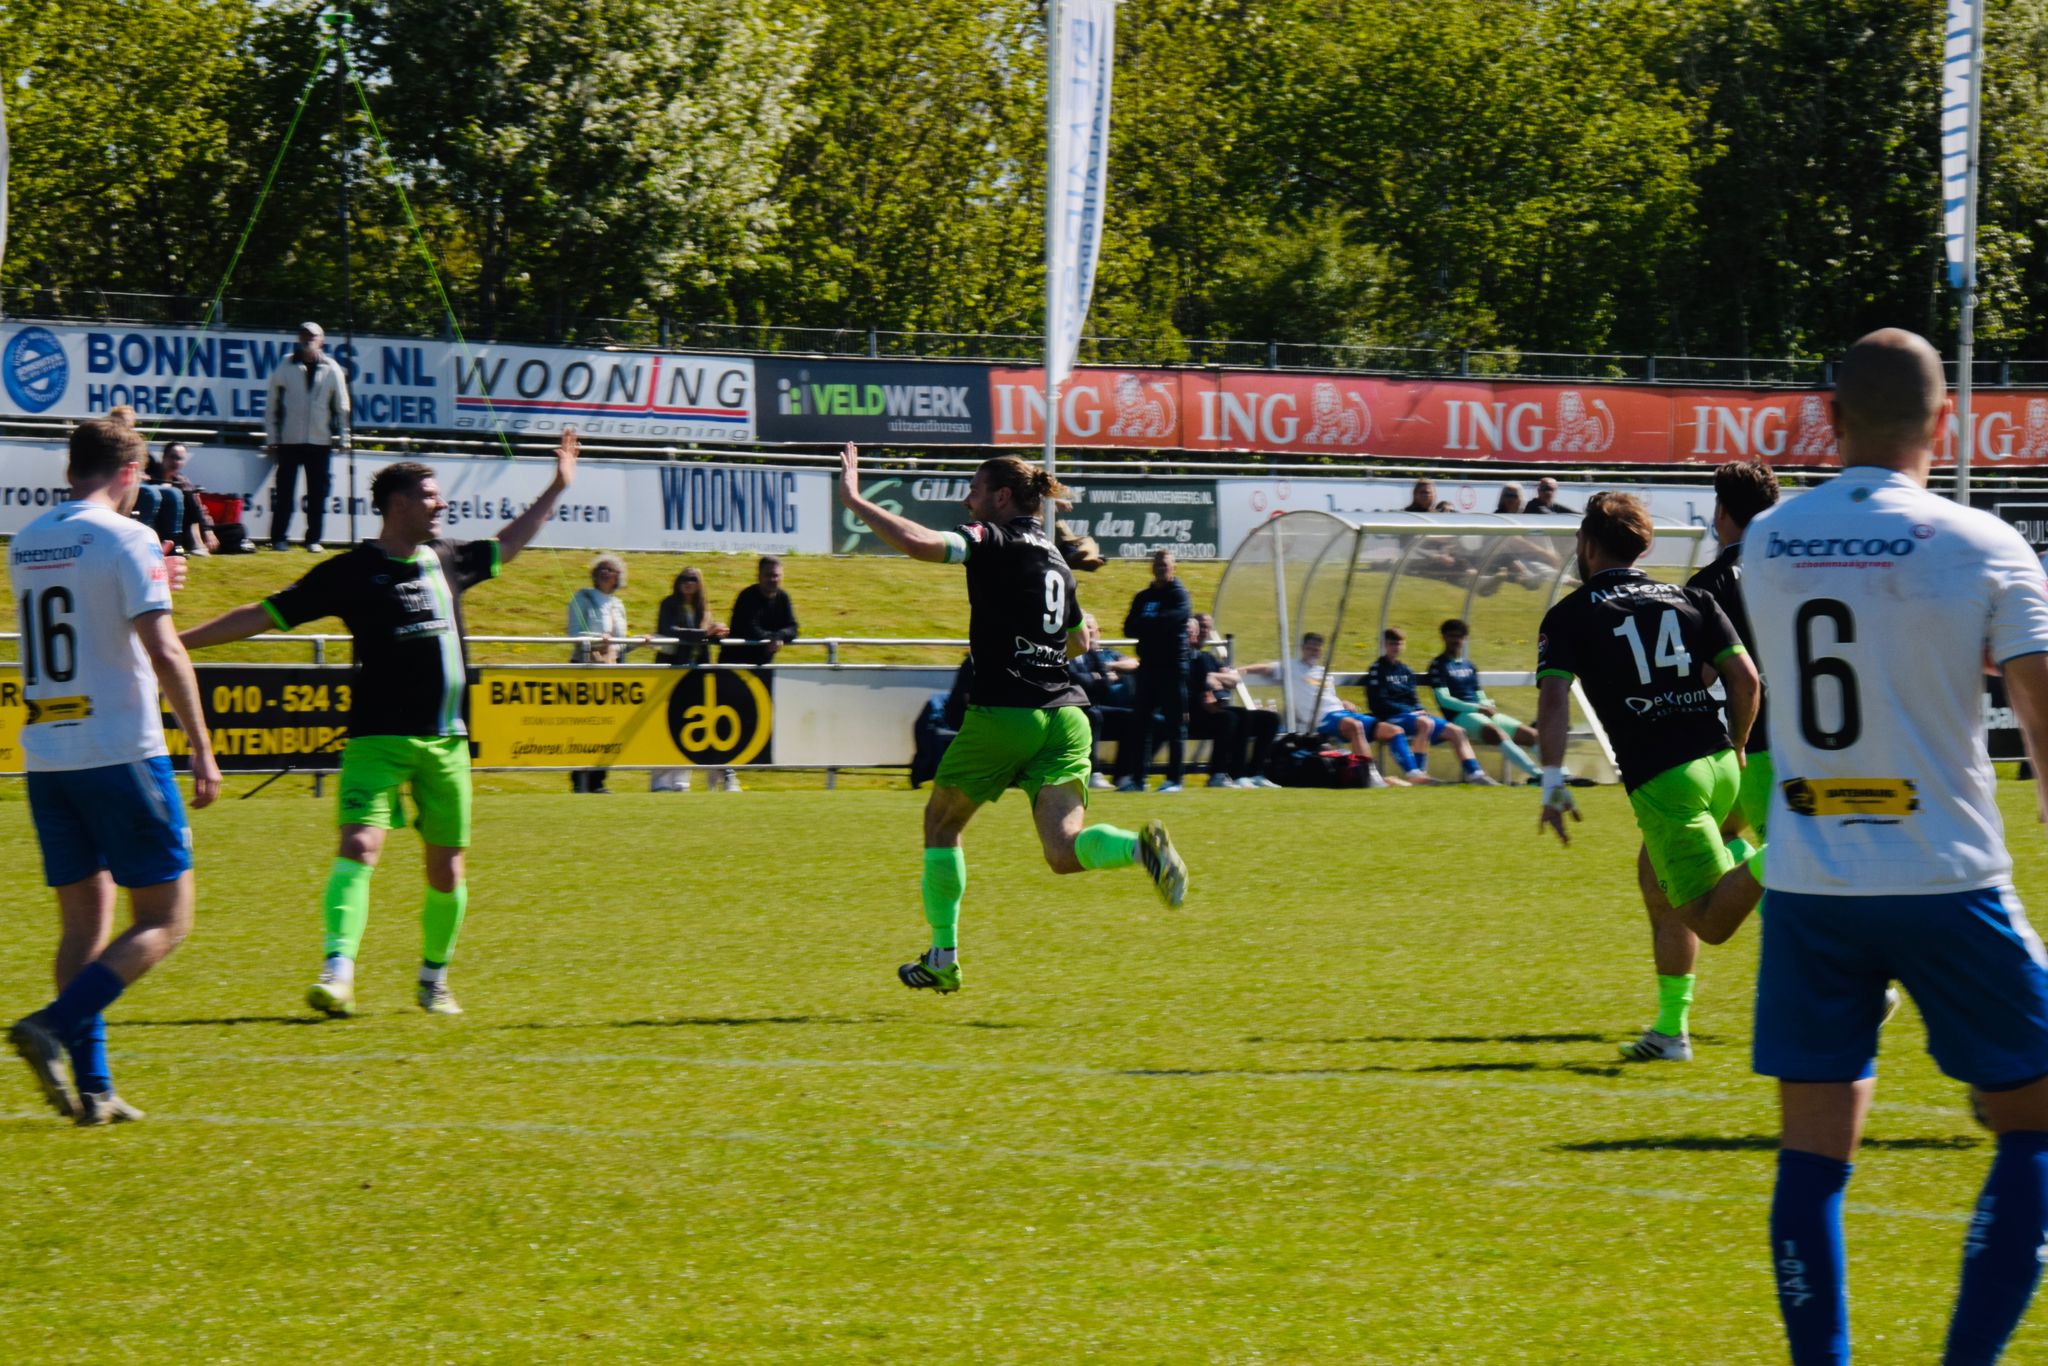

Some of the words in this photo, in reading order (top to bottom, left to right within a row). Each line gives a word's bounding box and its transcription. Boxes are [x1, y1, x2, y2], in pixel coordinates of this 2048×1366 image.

[87, 332, 437, 387] BONNEWS.NL
[456, 355, 750, 409] WOONING
[88, 384, 218, 416] HORECA
[232, 389, 437, 425] LENCIER
[811, 384, 972, 418] VELDWERK
[994, 384, 1104, 438] ING
[1196, 391, 1300, 445] ING
[1443, 400, 1546, 453] ING
[454, 415, 750, 442] airconditioning
[1692, 405, 1789, 456] ING
[1930, 411, 2015, 461] NG
[659, 466, 799, 533] WOONING
[1095, 512, 1135, 537] den
[1141, 512, 1193, 542] Berg
[1766, 531, 1916, 559] beercoo
[1042, 569, 1065, 634] 9
[21, 585, 77, 686] 16
[1612, 608, 1693, 685] 14
[489, 681, 646, 705] BATENBURG
[1793, 598, 1864, 751] 6
